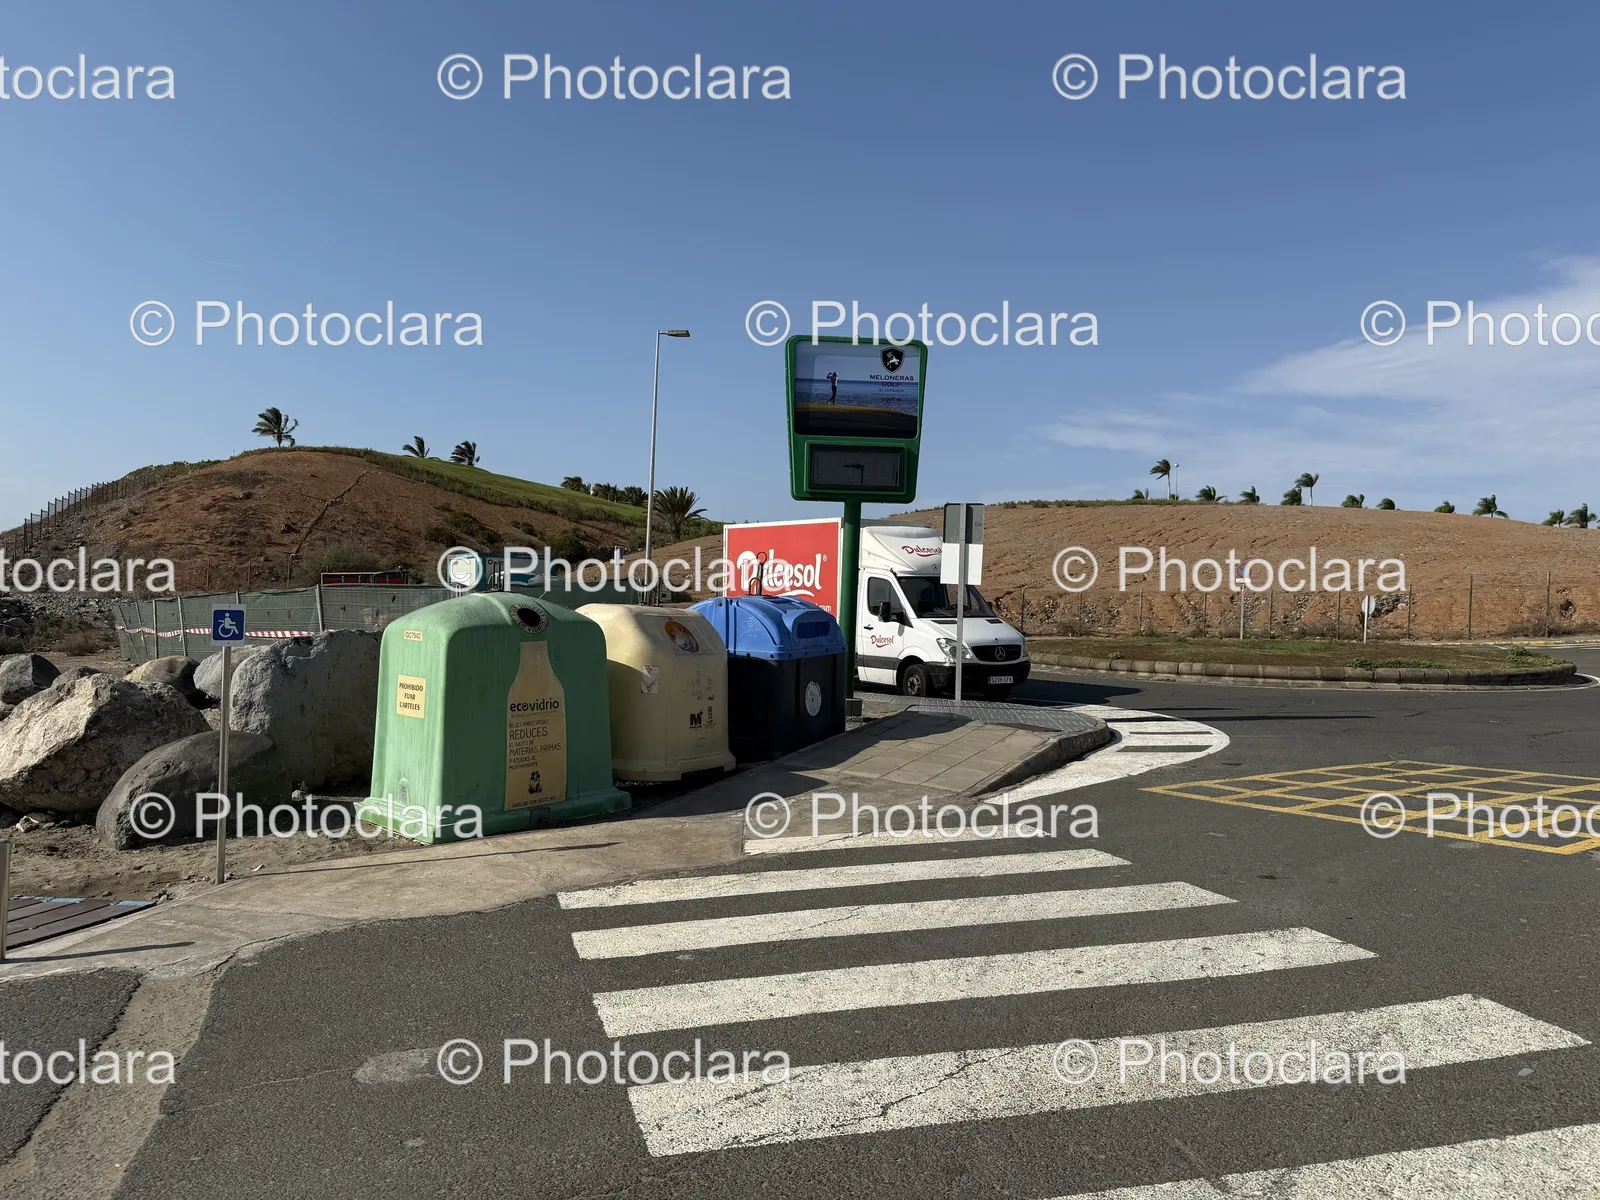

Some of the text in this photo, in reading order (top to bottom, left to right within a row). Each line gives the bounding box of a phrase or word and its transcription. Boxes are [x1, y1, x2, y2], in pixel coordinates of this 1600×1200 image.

[399, 682, 423, 692] PROHIBIDO
[400, 701, 420, 711] CARTELES
[510, 698, 559, 711] ecovidrio
[510, 727, 548, 740] REDUCES
[540, 743, 561, 752] PRIMAS
